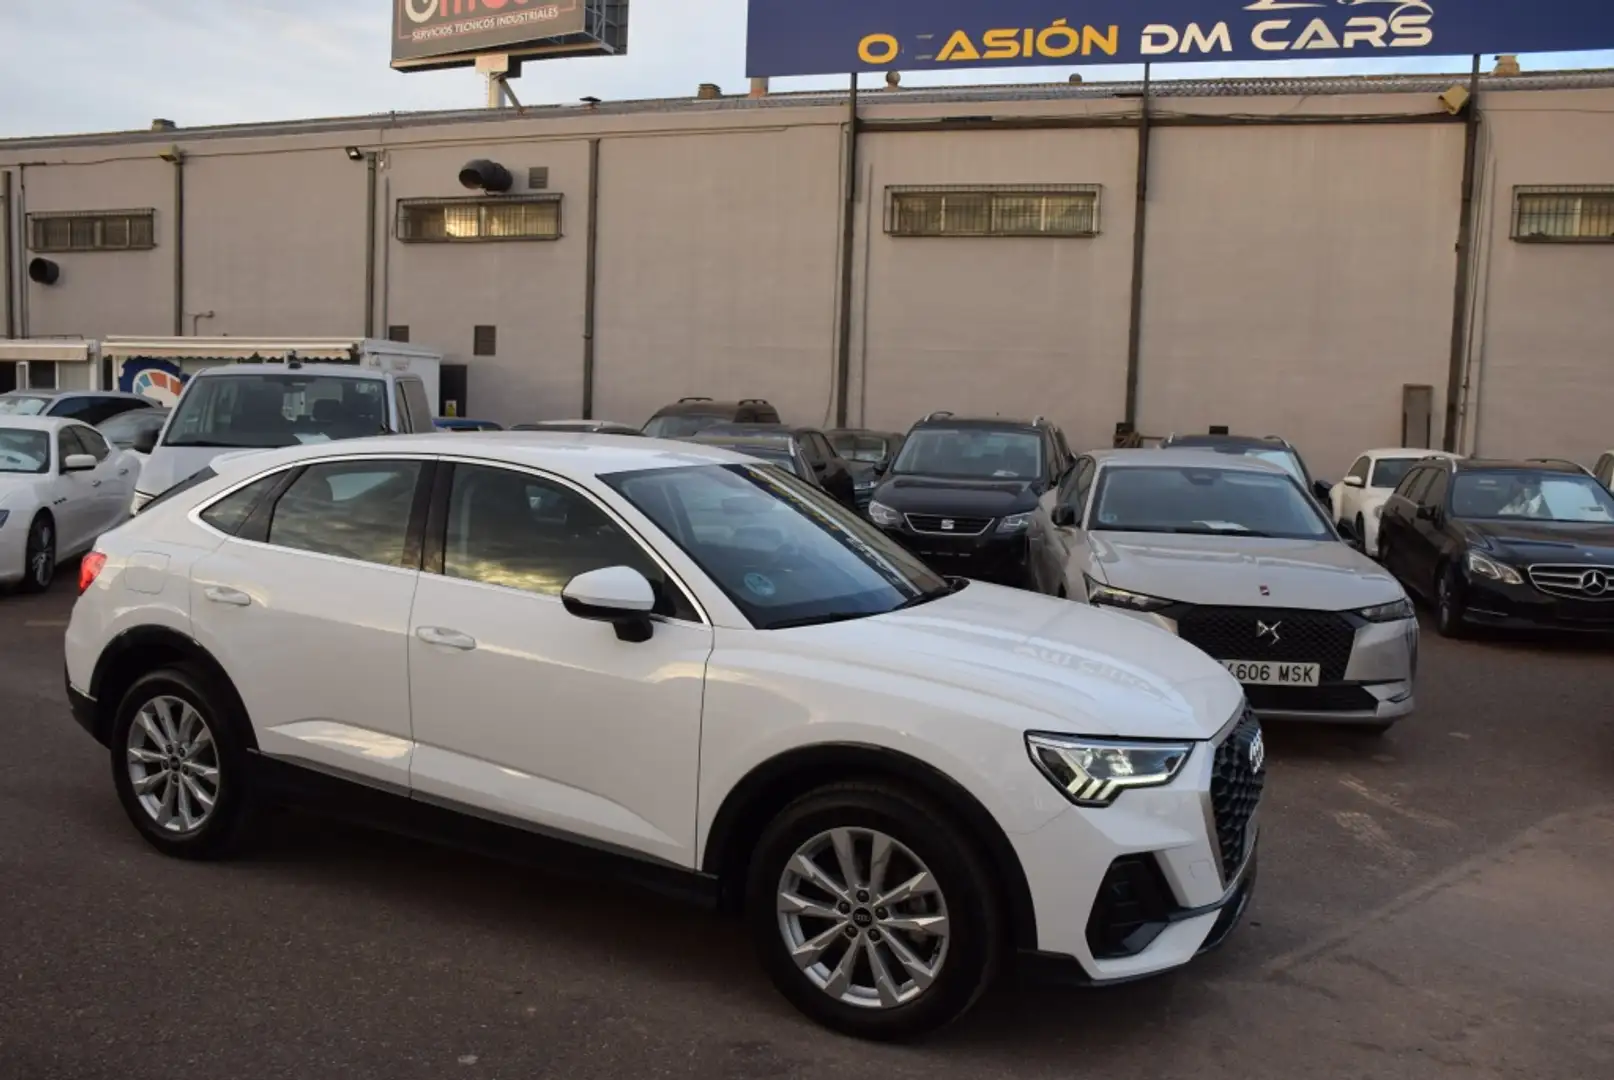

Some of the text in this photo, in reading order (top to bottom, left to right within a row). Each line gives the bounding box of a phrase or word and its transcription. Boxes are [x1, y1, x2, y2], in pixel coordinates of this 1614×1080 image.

[411, 24, 453, 41] SERVICIOS
[497, 6, 559, 26] INDUSTRIALES
[1140, 21, 1233, 54] DM
[1251, 15, 1434, 50] CARS
[1279, 664, 1313, 682] MSK
